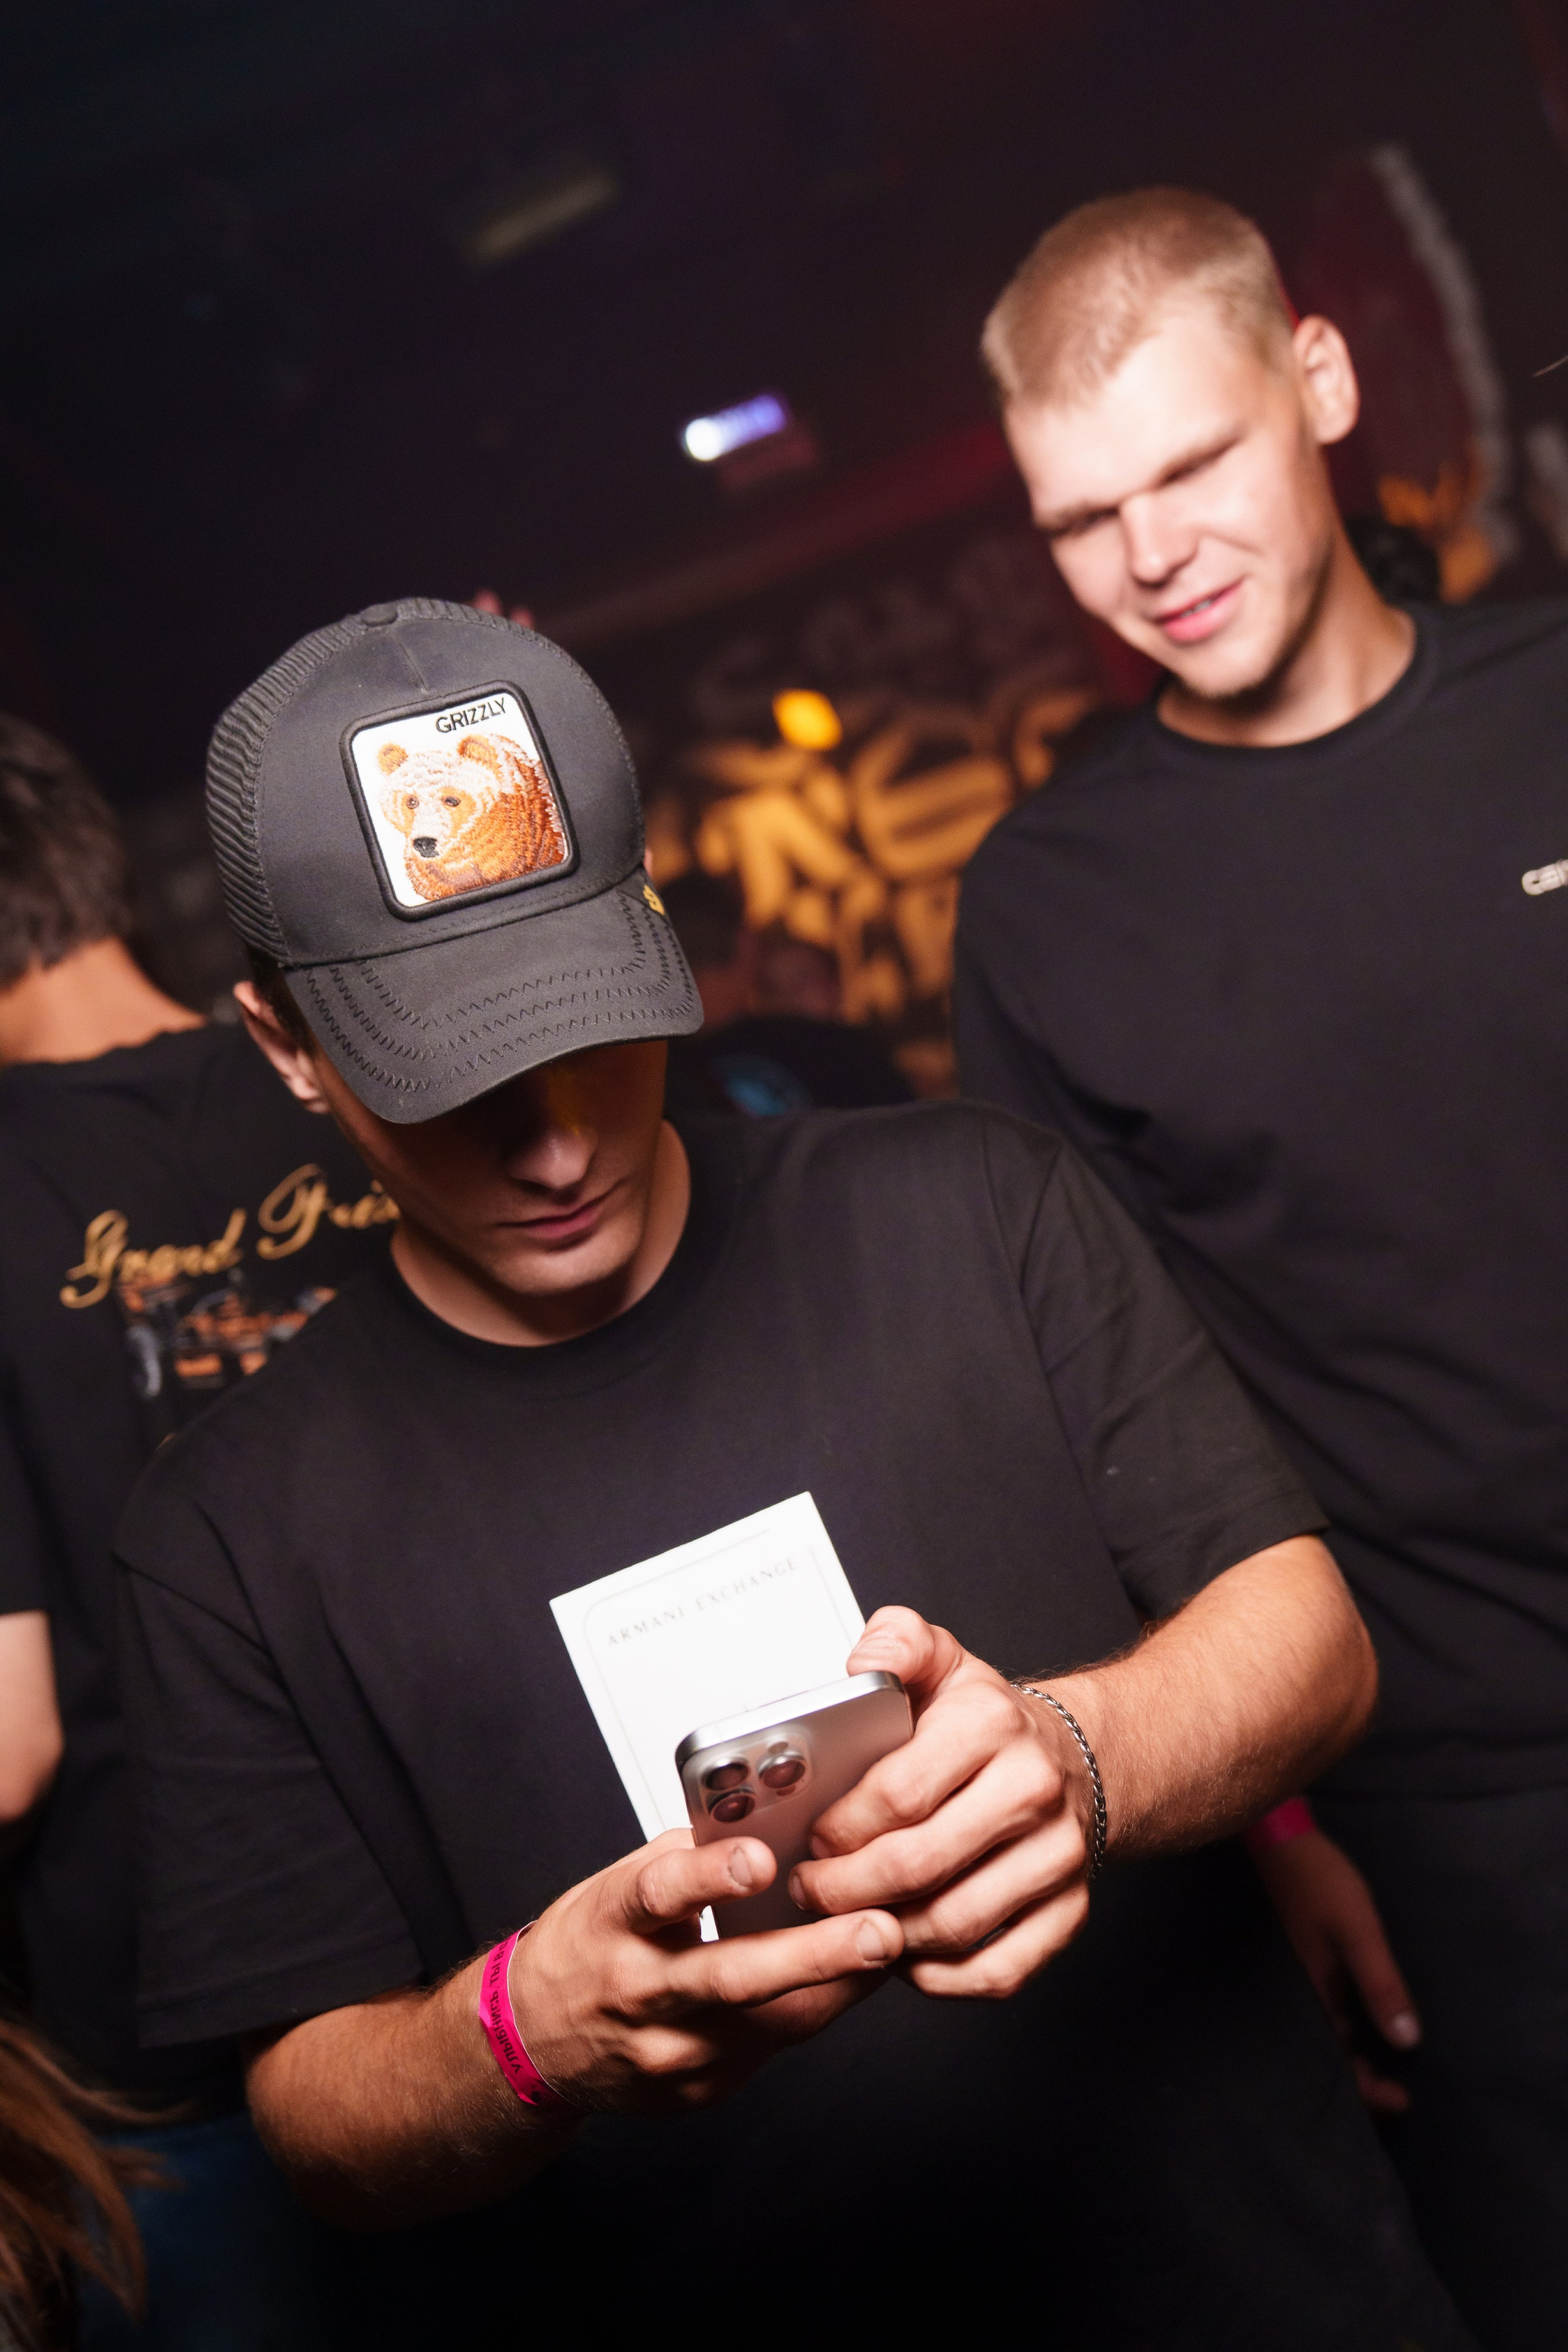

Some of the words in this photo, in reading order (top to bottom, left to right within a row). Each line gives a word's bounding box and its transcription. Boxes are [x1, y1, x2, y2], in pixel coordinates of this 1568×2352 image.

[437, 698, 506, 733] GRIZZLY
[608, 1606, 684, 1644] ARMANI
[695, 1556, 799, 1610] EXCHANGE
